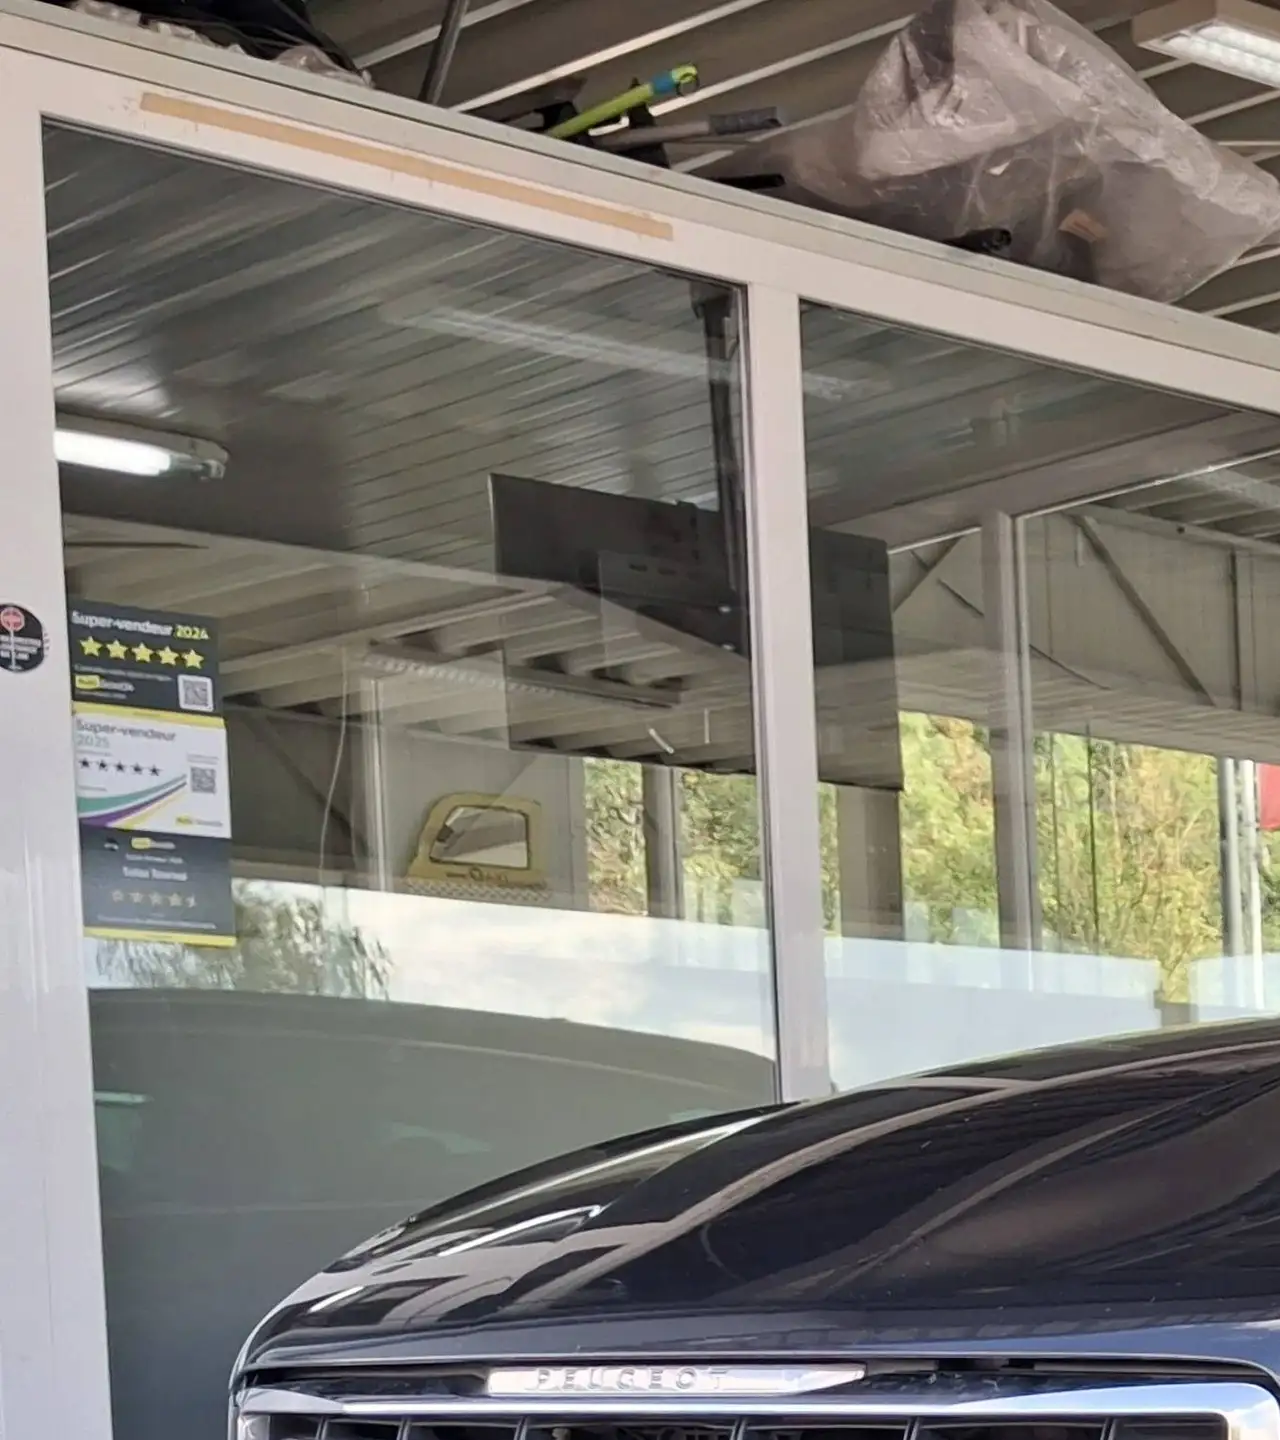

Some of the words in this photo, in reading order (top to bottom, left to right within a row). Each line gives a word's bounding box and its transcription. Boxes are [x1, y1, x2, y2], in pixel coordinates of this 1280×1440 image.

[72, 611, 173, 636] Super-vendeur
[175, 624, 209, 640] 2024
[76, 719, 176, 741] Super-vendeur
[535, 1367, 729, 1391] PEUGEOT
